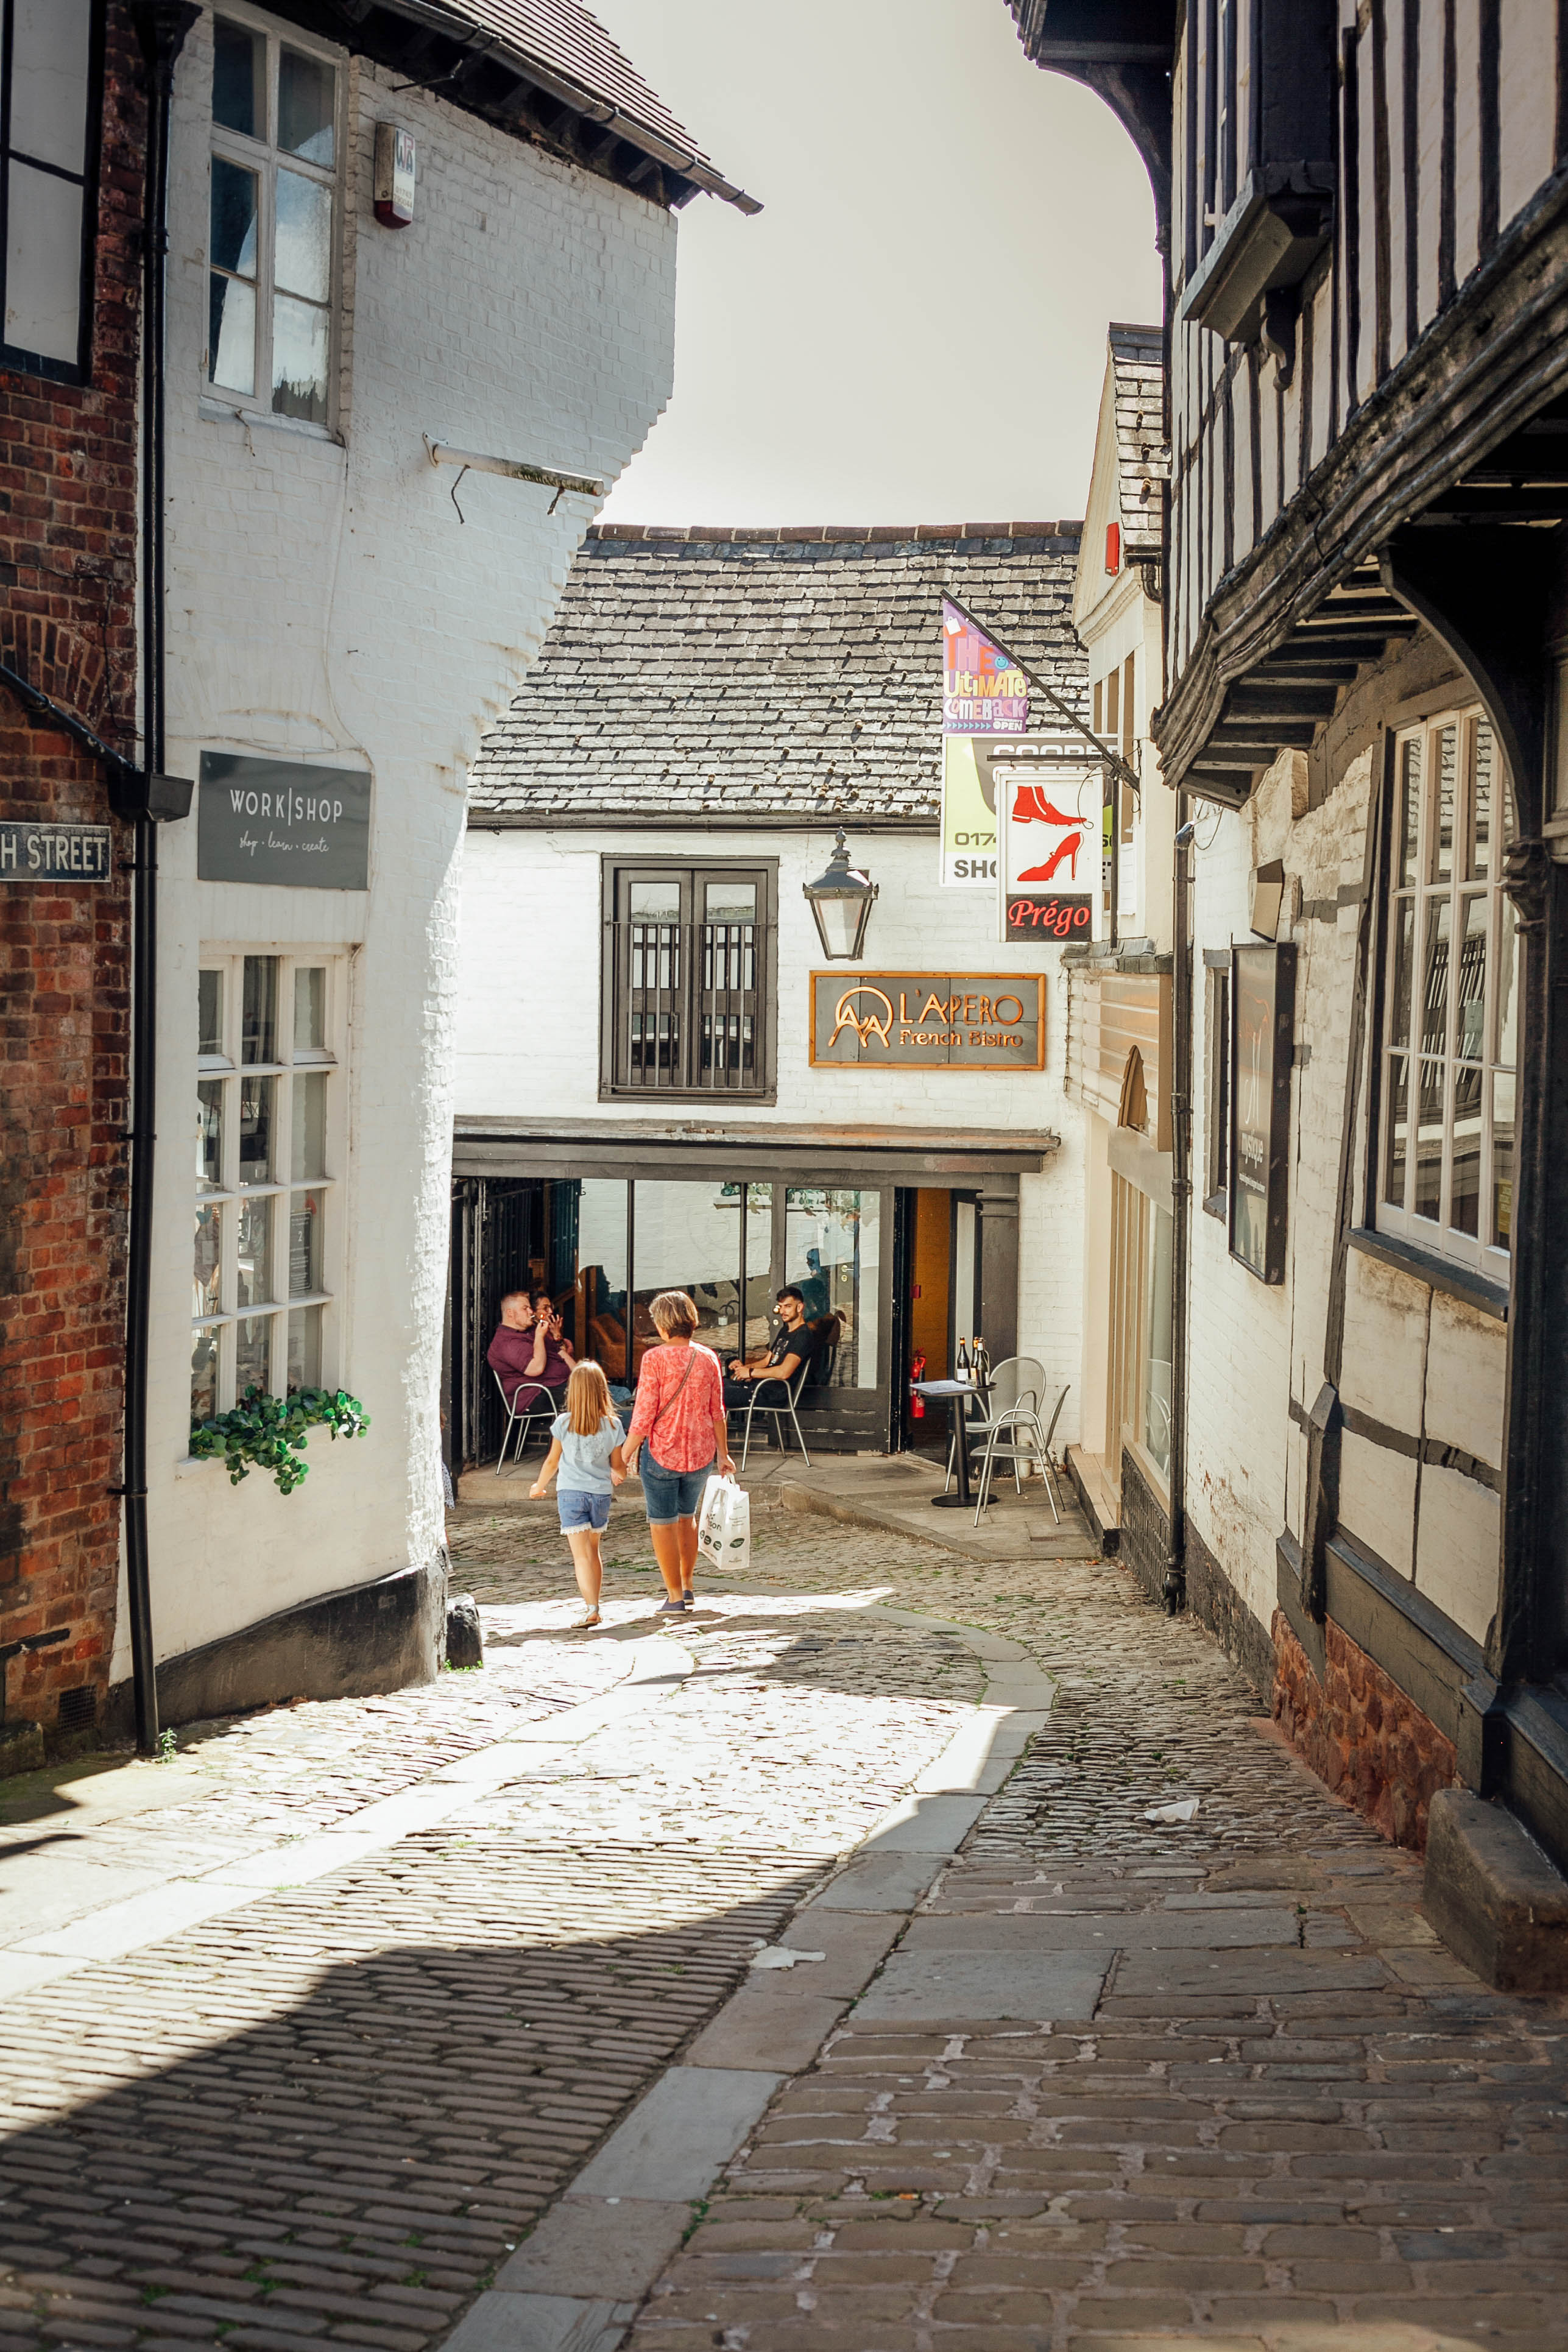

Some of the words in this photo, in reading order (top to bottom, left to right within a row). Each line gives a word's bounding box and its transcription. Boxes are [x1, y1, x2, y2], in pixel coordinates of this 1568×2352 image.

[943, 626, 995, 675] THE
[993, 721, 1023, 731] OPEN
[27, 834, 106, 871] STREET
[239, 830, 258, 856] shop
[268, 832, 293, 851] learn
[302, 837, 330, 853] create
[1008, 900, 1090, 936] Prégo
[899, 1028, 962, 1046] French
[968, 1030, 1023, 1047] Bistro
